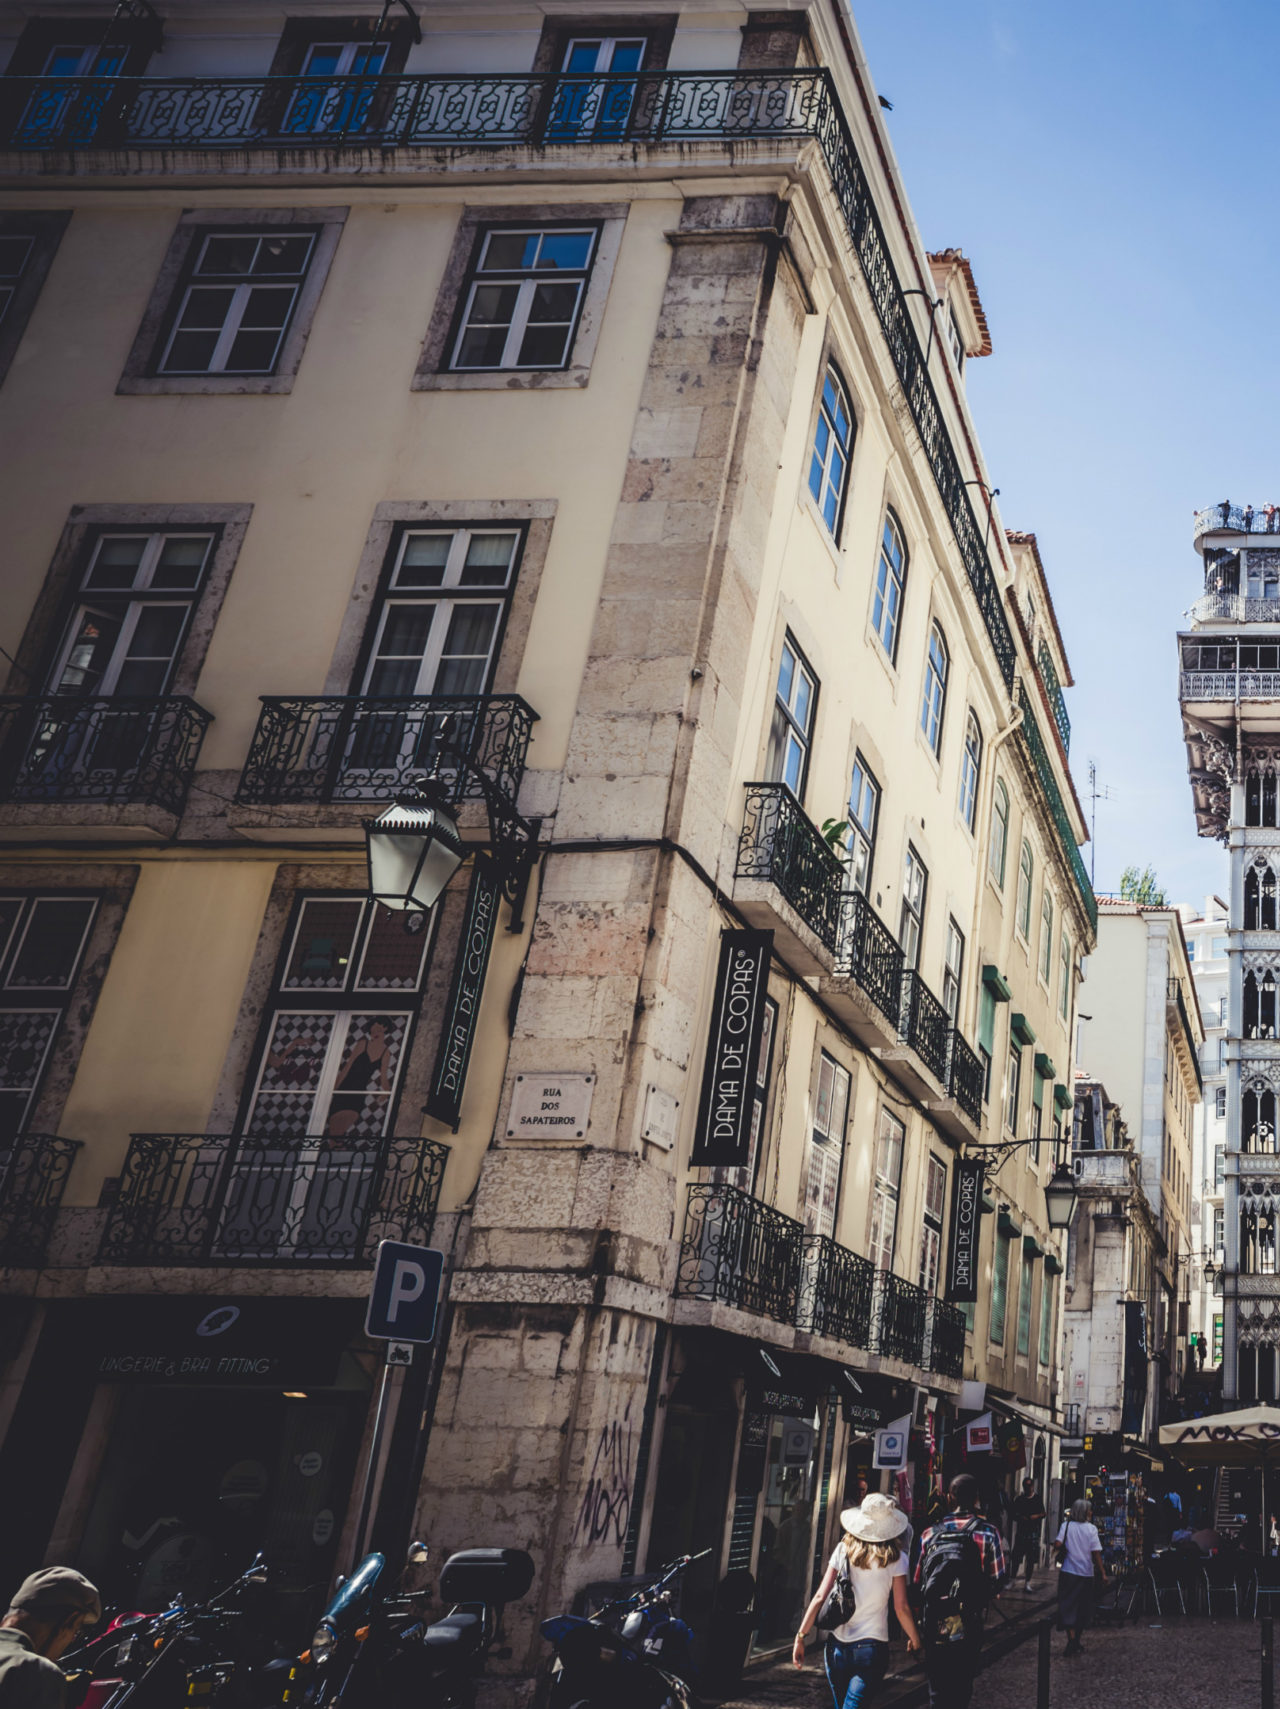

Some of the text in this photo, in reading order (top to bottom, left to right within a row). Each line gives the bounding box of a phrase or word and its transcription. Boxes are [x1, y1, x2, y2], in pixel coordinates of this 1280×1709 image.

[443, 890, 492, 1091] DAMA DE COPAS
[721, 1043, 744, 1070] DE
[543, 1088, 562, 1097] RUA
[540, 1102, 560, 1110] DOS
[713, 1080, 740, 1138] DAMA
[520, 1116, 576, 1125] SAPATEIROS
[958, 1228, 971, 1245] DE
[956, 1250, 969, 1285] DAMA
[386, 1259, 426, 1323] P
[99, 1355, 166, 1373] LINGERIE
[180, 1356, 212, 1373] BRA
[217, 1357, 270, 1374] FITTING
